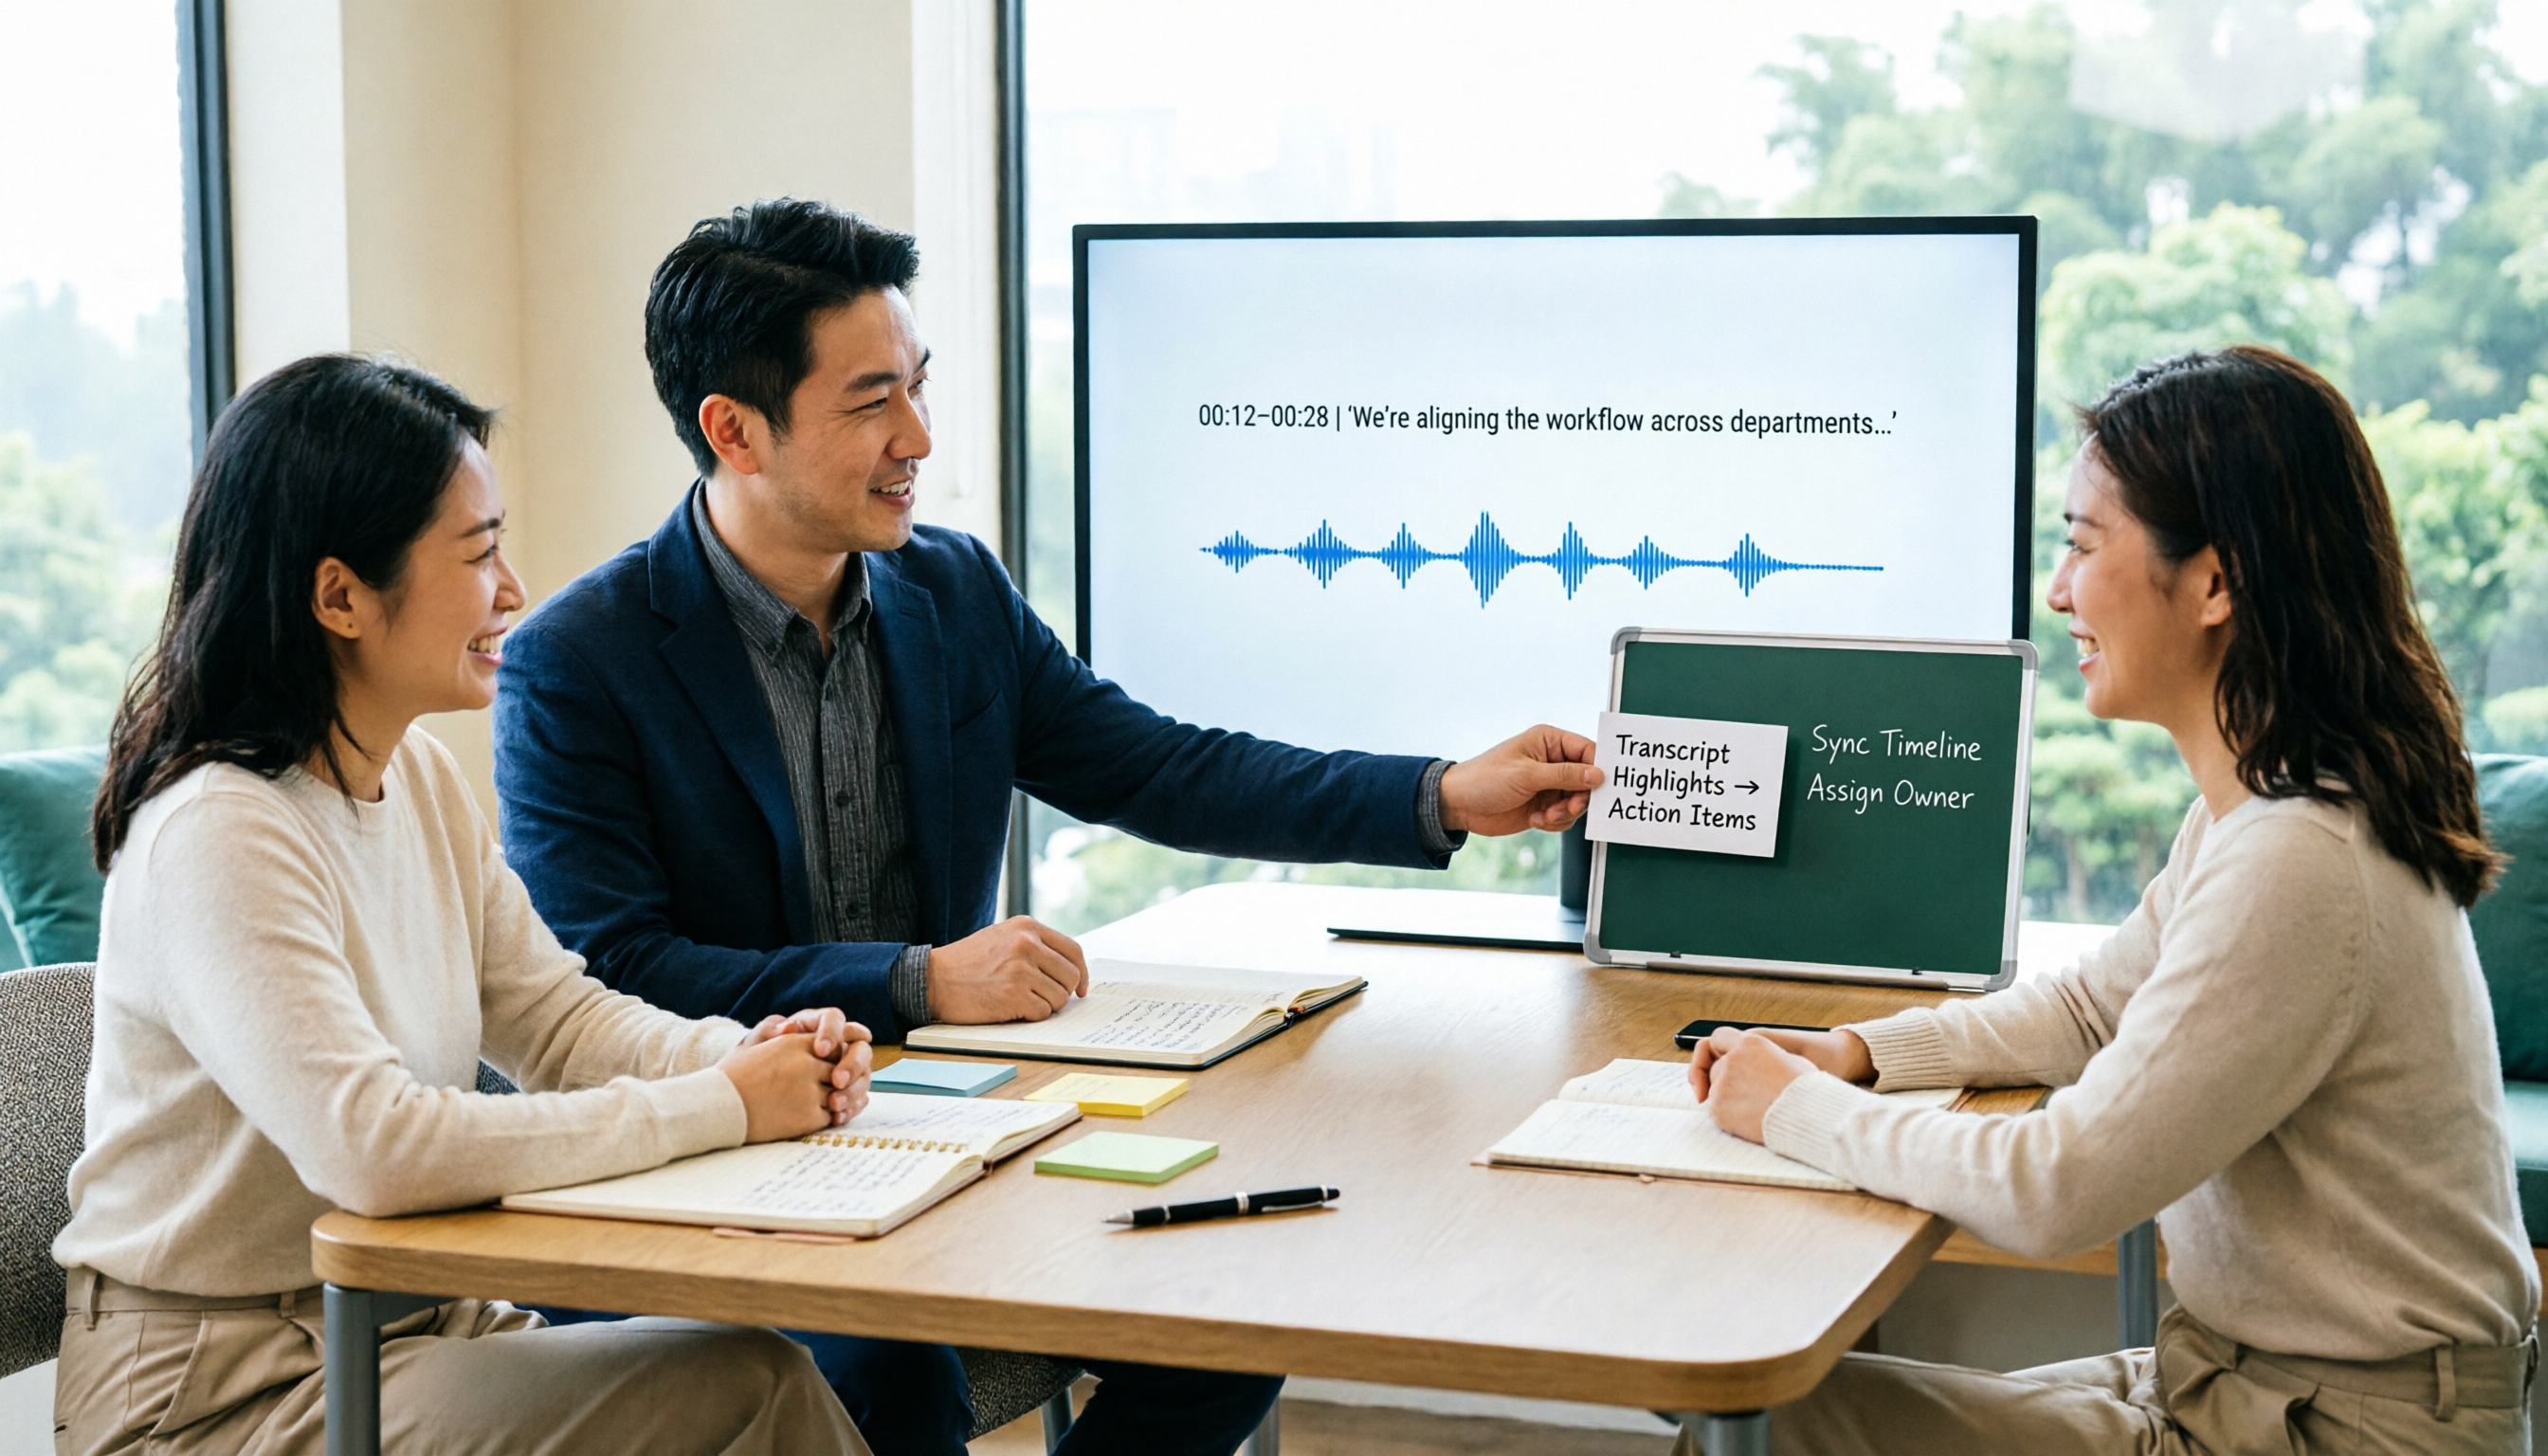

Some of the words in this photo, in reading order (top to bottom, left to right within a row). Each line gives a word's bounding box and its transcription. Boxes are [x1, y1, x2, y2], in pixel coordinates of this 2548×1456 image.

[1416, 405, 1500, 436] aligning
[1504, 406, 1539, 430] the
[1546, 407, 1644, 431] workflow
[1650, 413, 1723, 432] across
[1615, 734, 1731, 770] Transcript
[1811, 723, 1870, 765] Sync
[1879, 728, 1982, 761] Timeline
[1613, 766, 1725, 799] Highlights
[1807, 773, 1884, 815] Assign
[1894, 779, 1975, 810] Owner
[1608, 797, 1681, 824] Action
[1689, 804, 1756, 831] Items
